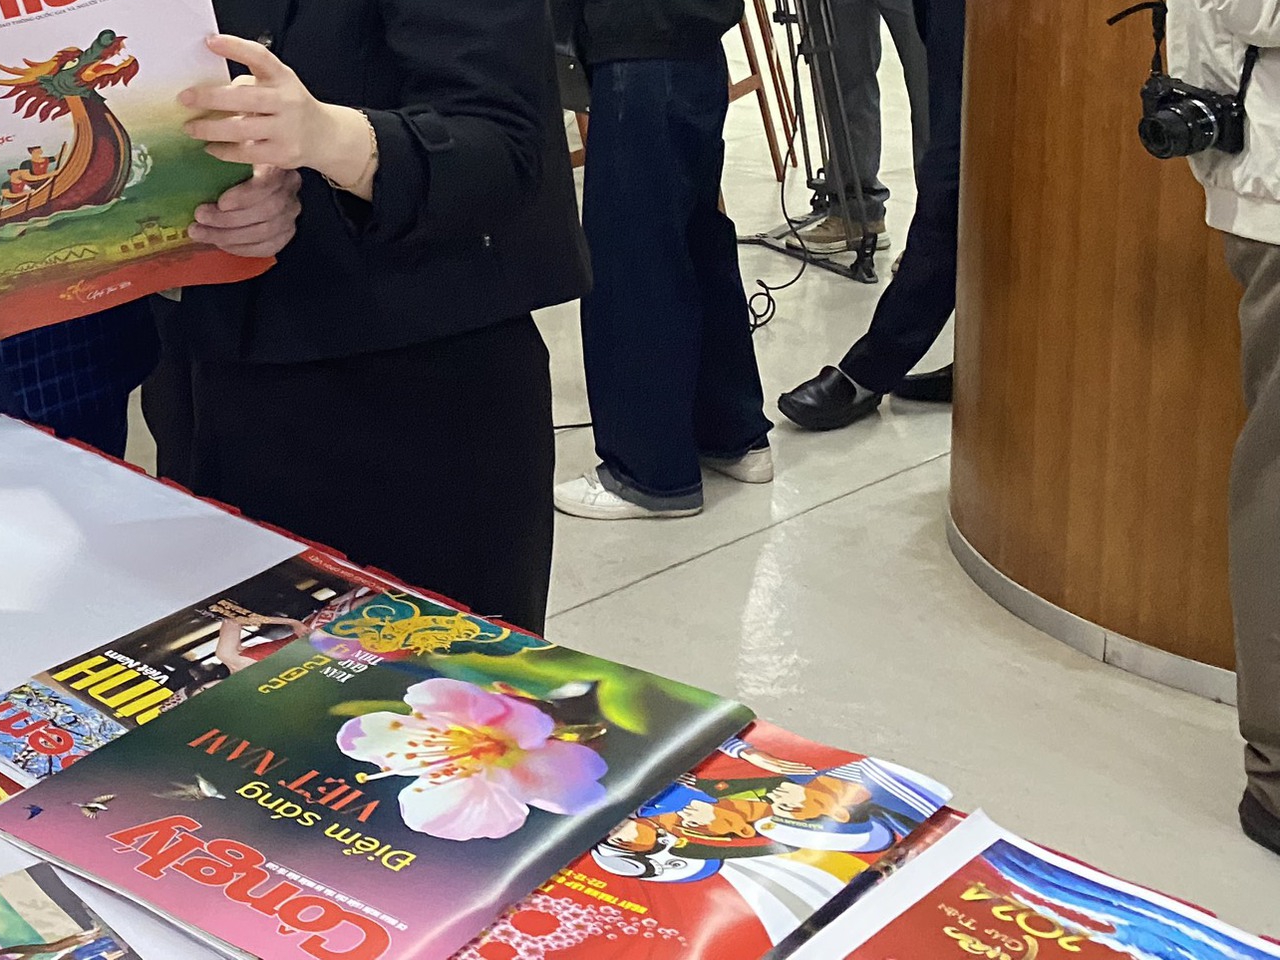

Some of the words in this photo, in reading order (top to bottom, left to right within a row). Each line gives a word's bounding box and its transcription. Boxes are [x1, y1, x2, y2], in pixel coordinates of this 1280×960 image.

[104, 649, 142, 668] Nam
[139, 664, 170, 685] Việt
[187, 728, 287, 777] NAM
[235, 781, 322, 826] sáng
[277, 769, 381, 823] VIỆT
[324, 823, 417, 872] Điểm
[960, 881, 1082, 952] 2024
